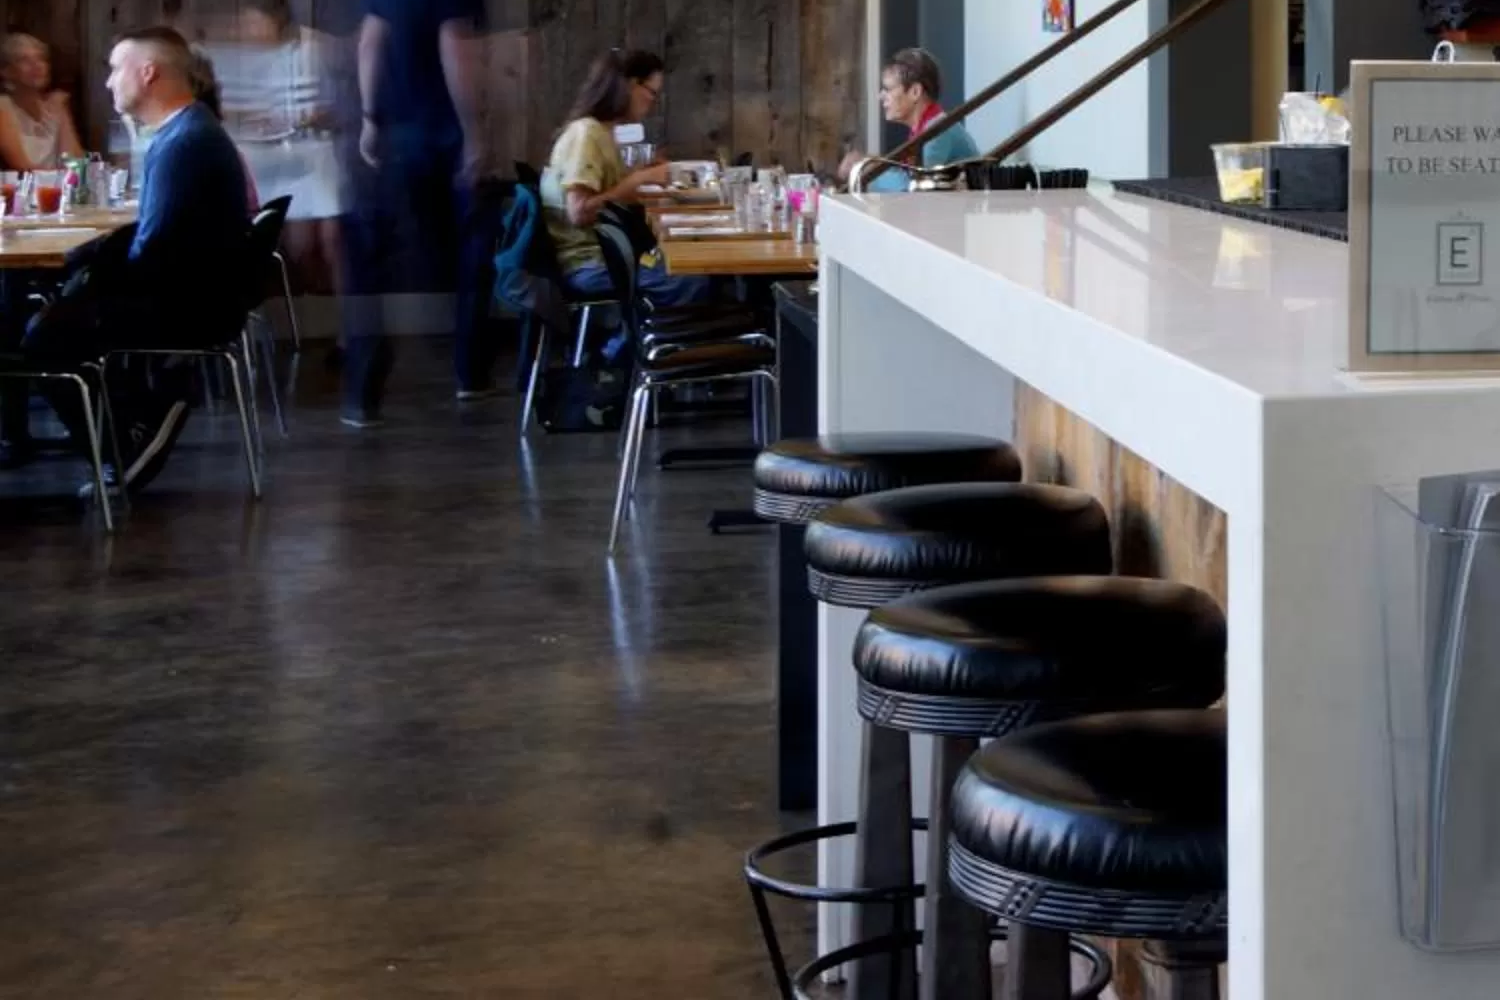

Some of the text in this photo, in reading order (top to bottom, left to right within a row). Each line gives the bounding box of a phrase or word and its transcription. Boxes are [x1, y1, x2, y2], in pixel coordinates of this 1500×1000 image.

[1393, 125, 1466, 144] PLEASE
[1386, 156, 1412, 175] TO
[1419, 156, 1443, 175] BE
[1450, 236, 1471, 269] E
